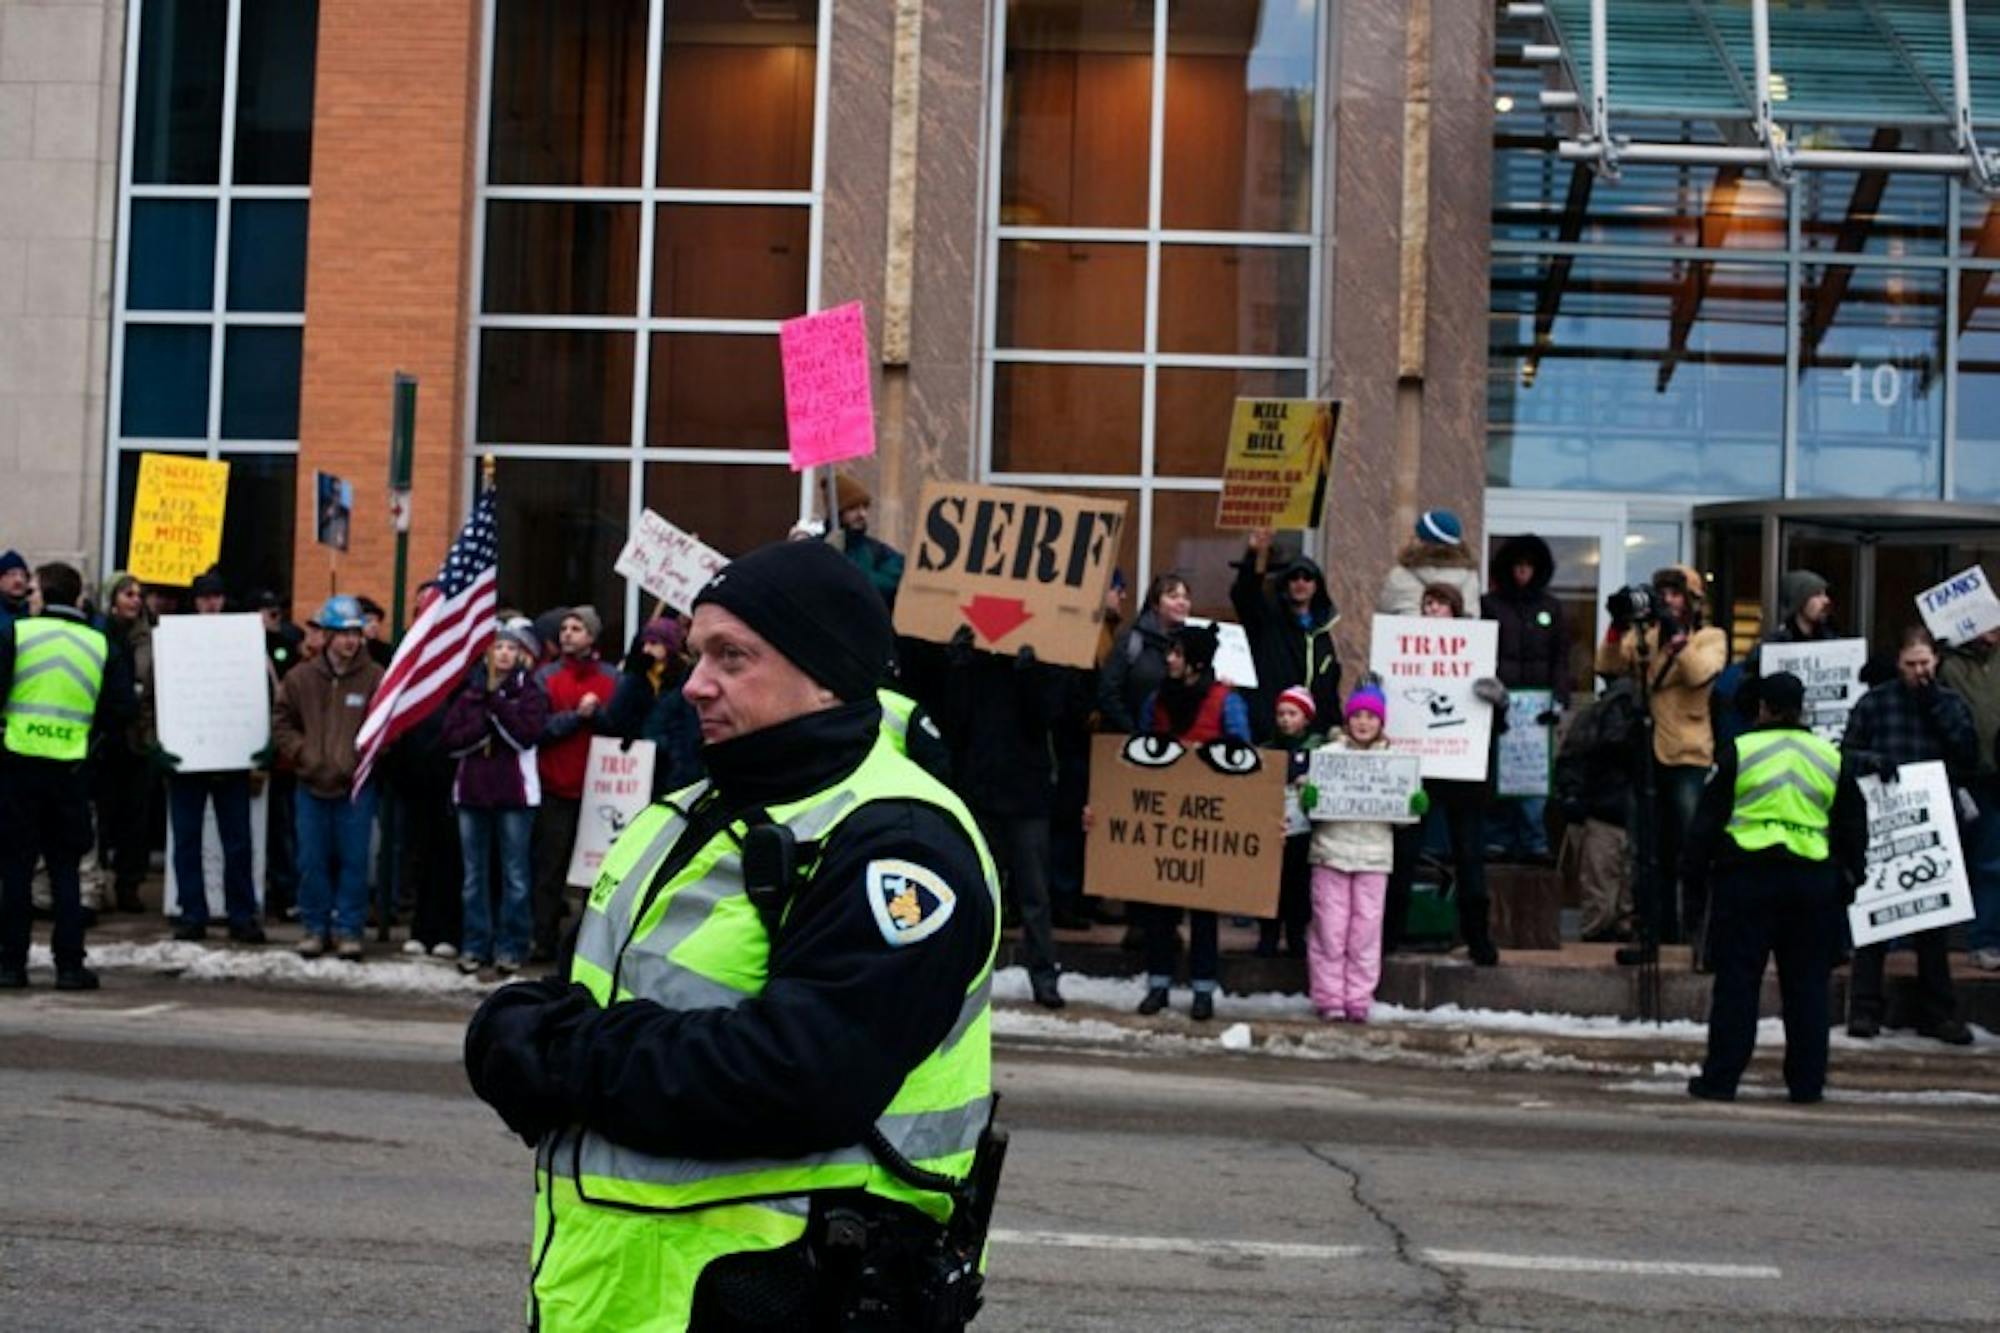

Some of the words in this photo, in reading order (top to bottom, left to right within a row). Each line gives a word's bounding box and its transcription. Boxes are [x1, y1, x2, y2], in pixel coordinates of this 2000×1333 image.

[1842, 362, 1900, 406] 10
[1253, 403, 1287, 419] KILL
[1247, 433, 1284, 450] BILL
[917, 496, 1121, 588] SERF
[1923, 573, 1980, 613] THANKS
[1397, 635, 1467, 656] TRAP
[1390, 662, 1423, 677] THE
[1431, 662, 1474, 678] RAT
[601, 757, 638, 774] TRAP
[616, 780, 640, 795] RAT
[1132, 788, 1166, 816] WE
[1180, 795, 1224, 821] ARE
[1109, 818, 1261, 857] WATCHING
